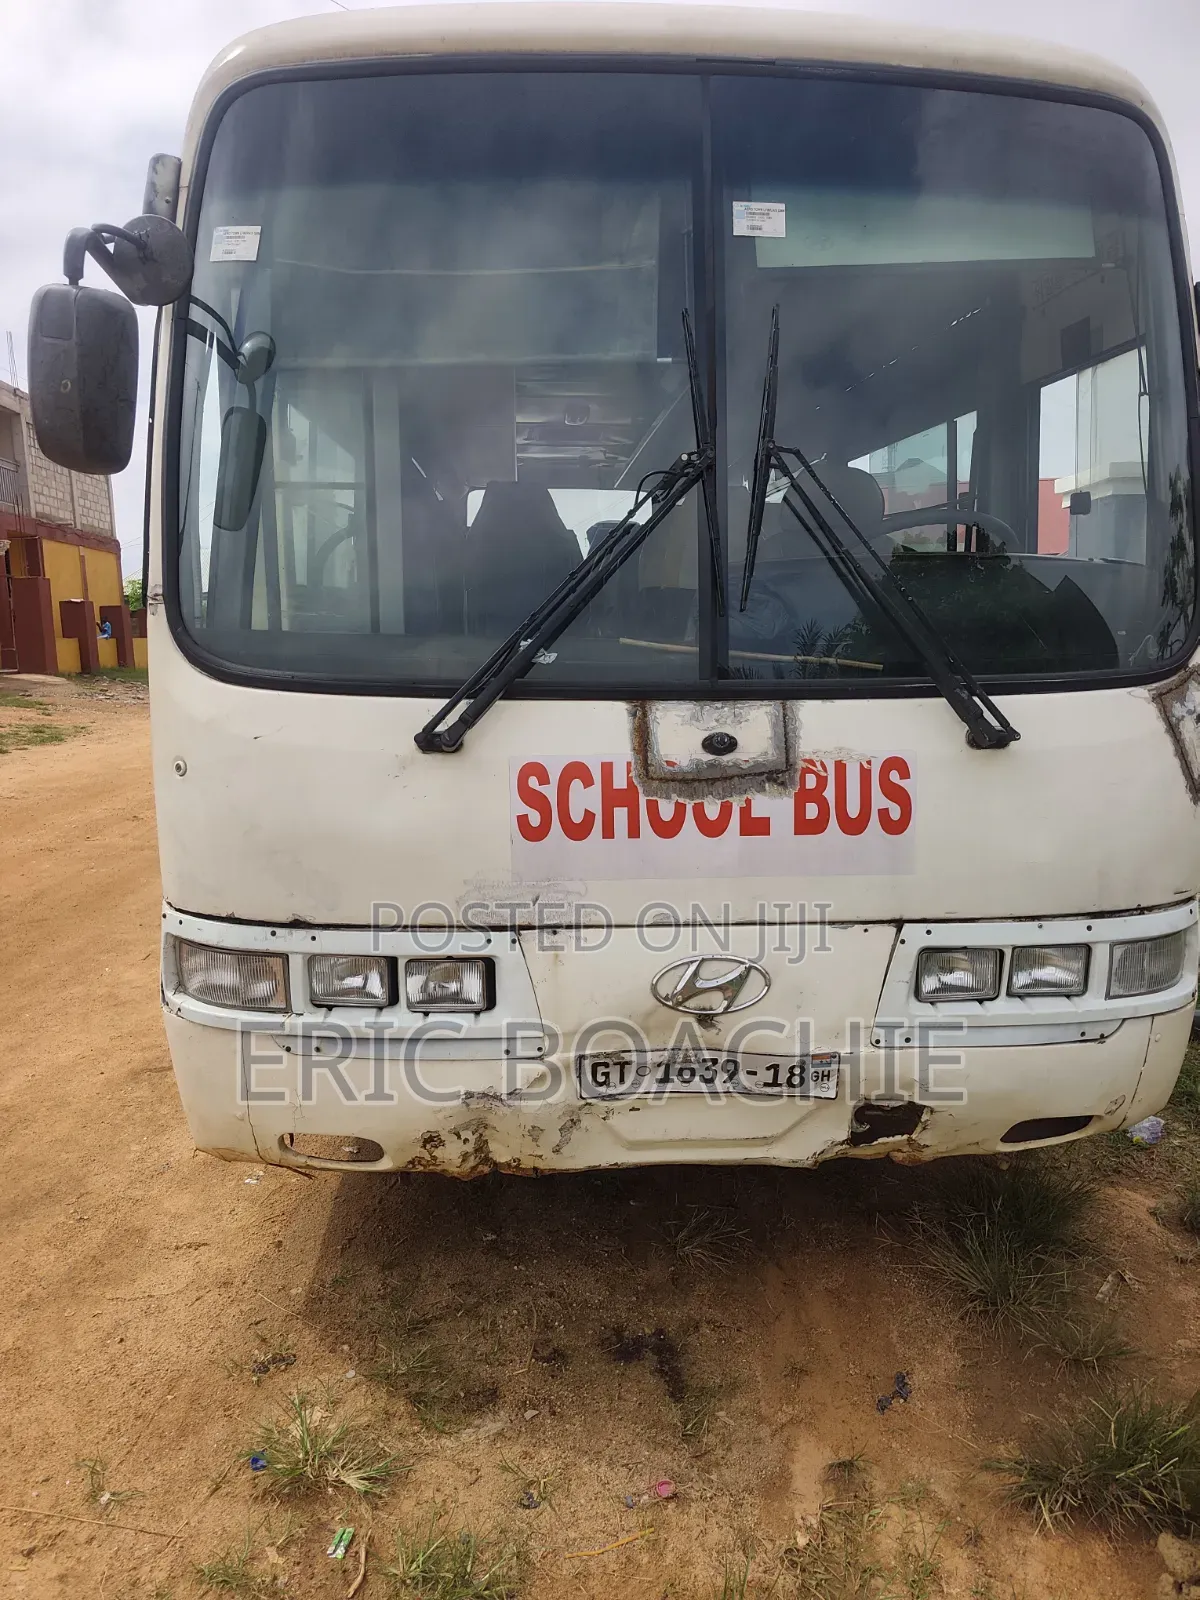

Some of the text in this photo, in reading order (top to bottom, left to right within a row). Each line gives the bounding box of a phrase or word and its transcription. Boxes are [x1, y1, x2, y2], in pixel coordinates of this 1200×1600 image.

[793, 756, 911, 835] BUS
[591, 1061, 632, 1087] GT
[811, 1070, 831, 1082] GH
